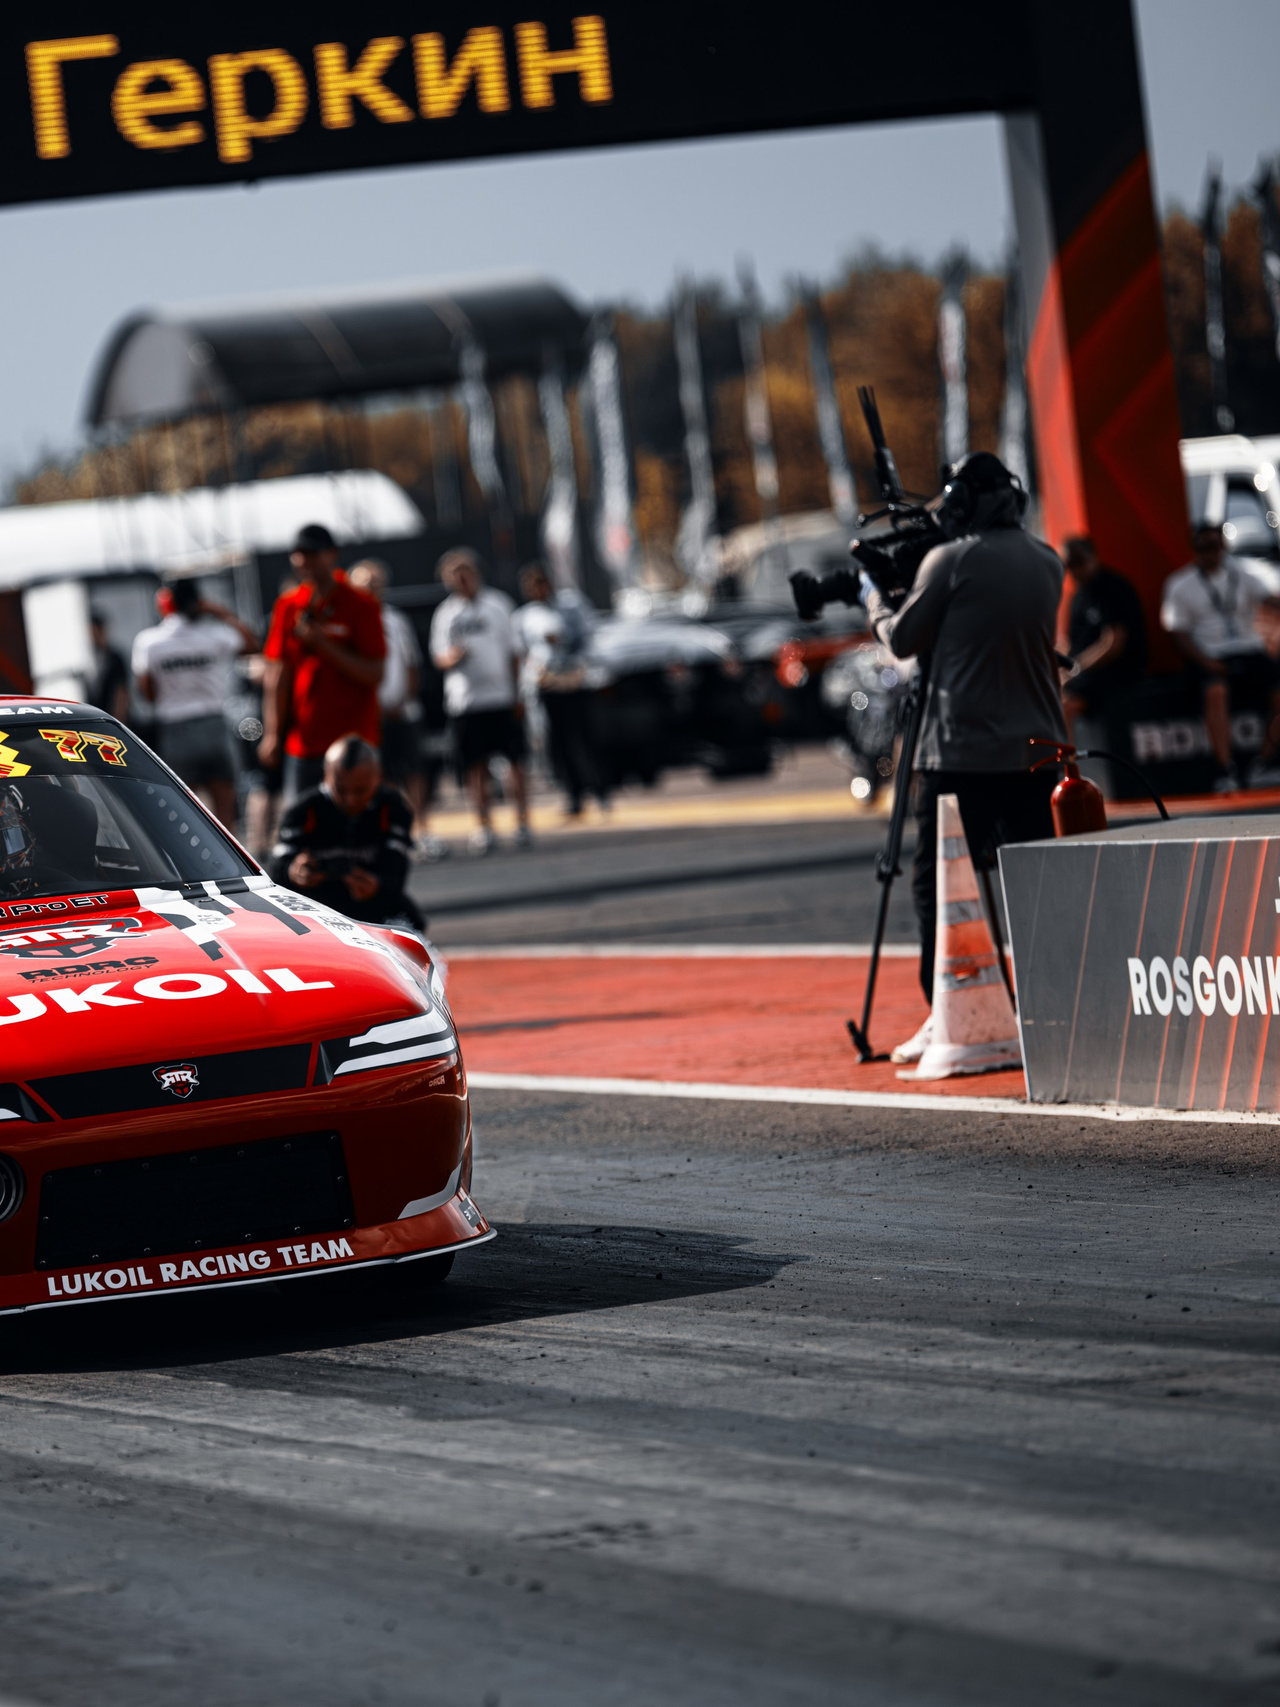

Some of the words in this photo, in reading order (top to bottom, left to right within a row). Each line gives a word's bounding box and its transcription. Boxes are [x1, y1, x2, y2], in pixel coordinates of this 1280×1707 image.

[24, 14, 614, 163] Геркин
[38, 728, 128, 767] 77
[9, 900, 66, 917] Pro
[69, 894, 110, 910] ET
[16, 955, 160, 981] RDRC
[28, 964, 155, 984] TECHNOLOGY
[47, 1266, 153, 1296] LUKOIL
[159, 1249, 271, 1283] RACING
[277, 1238, 355, 1266] TEAM
